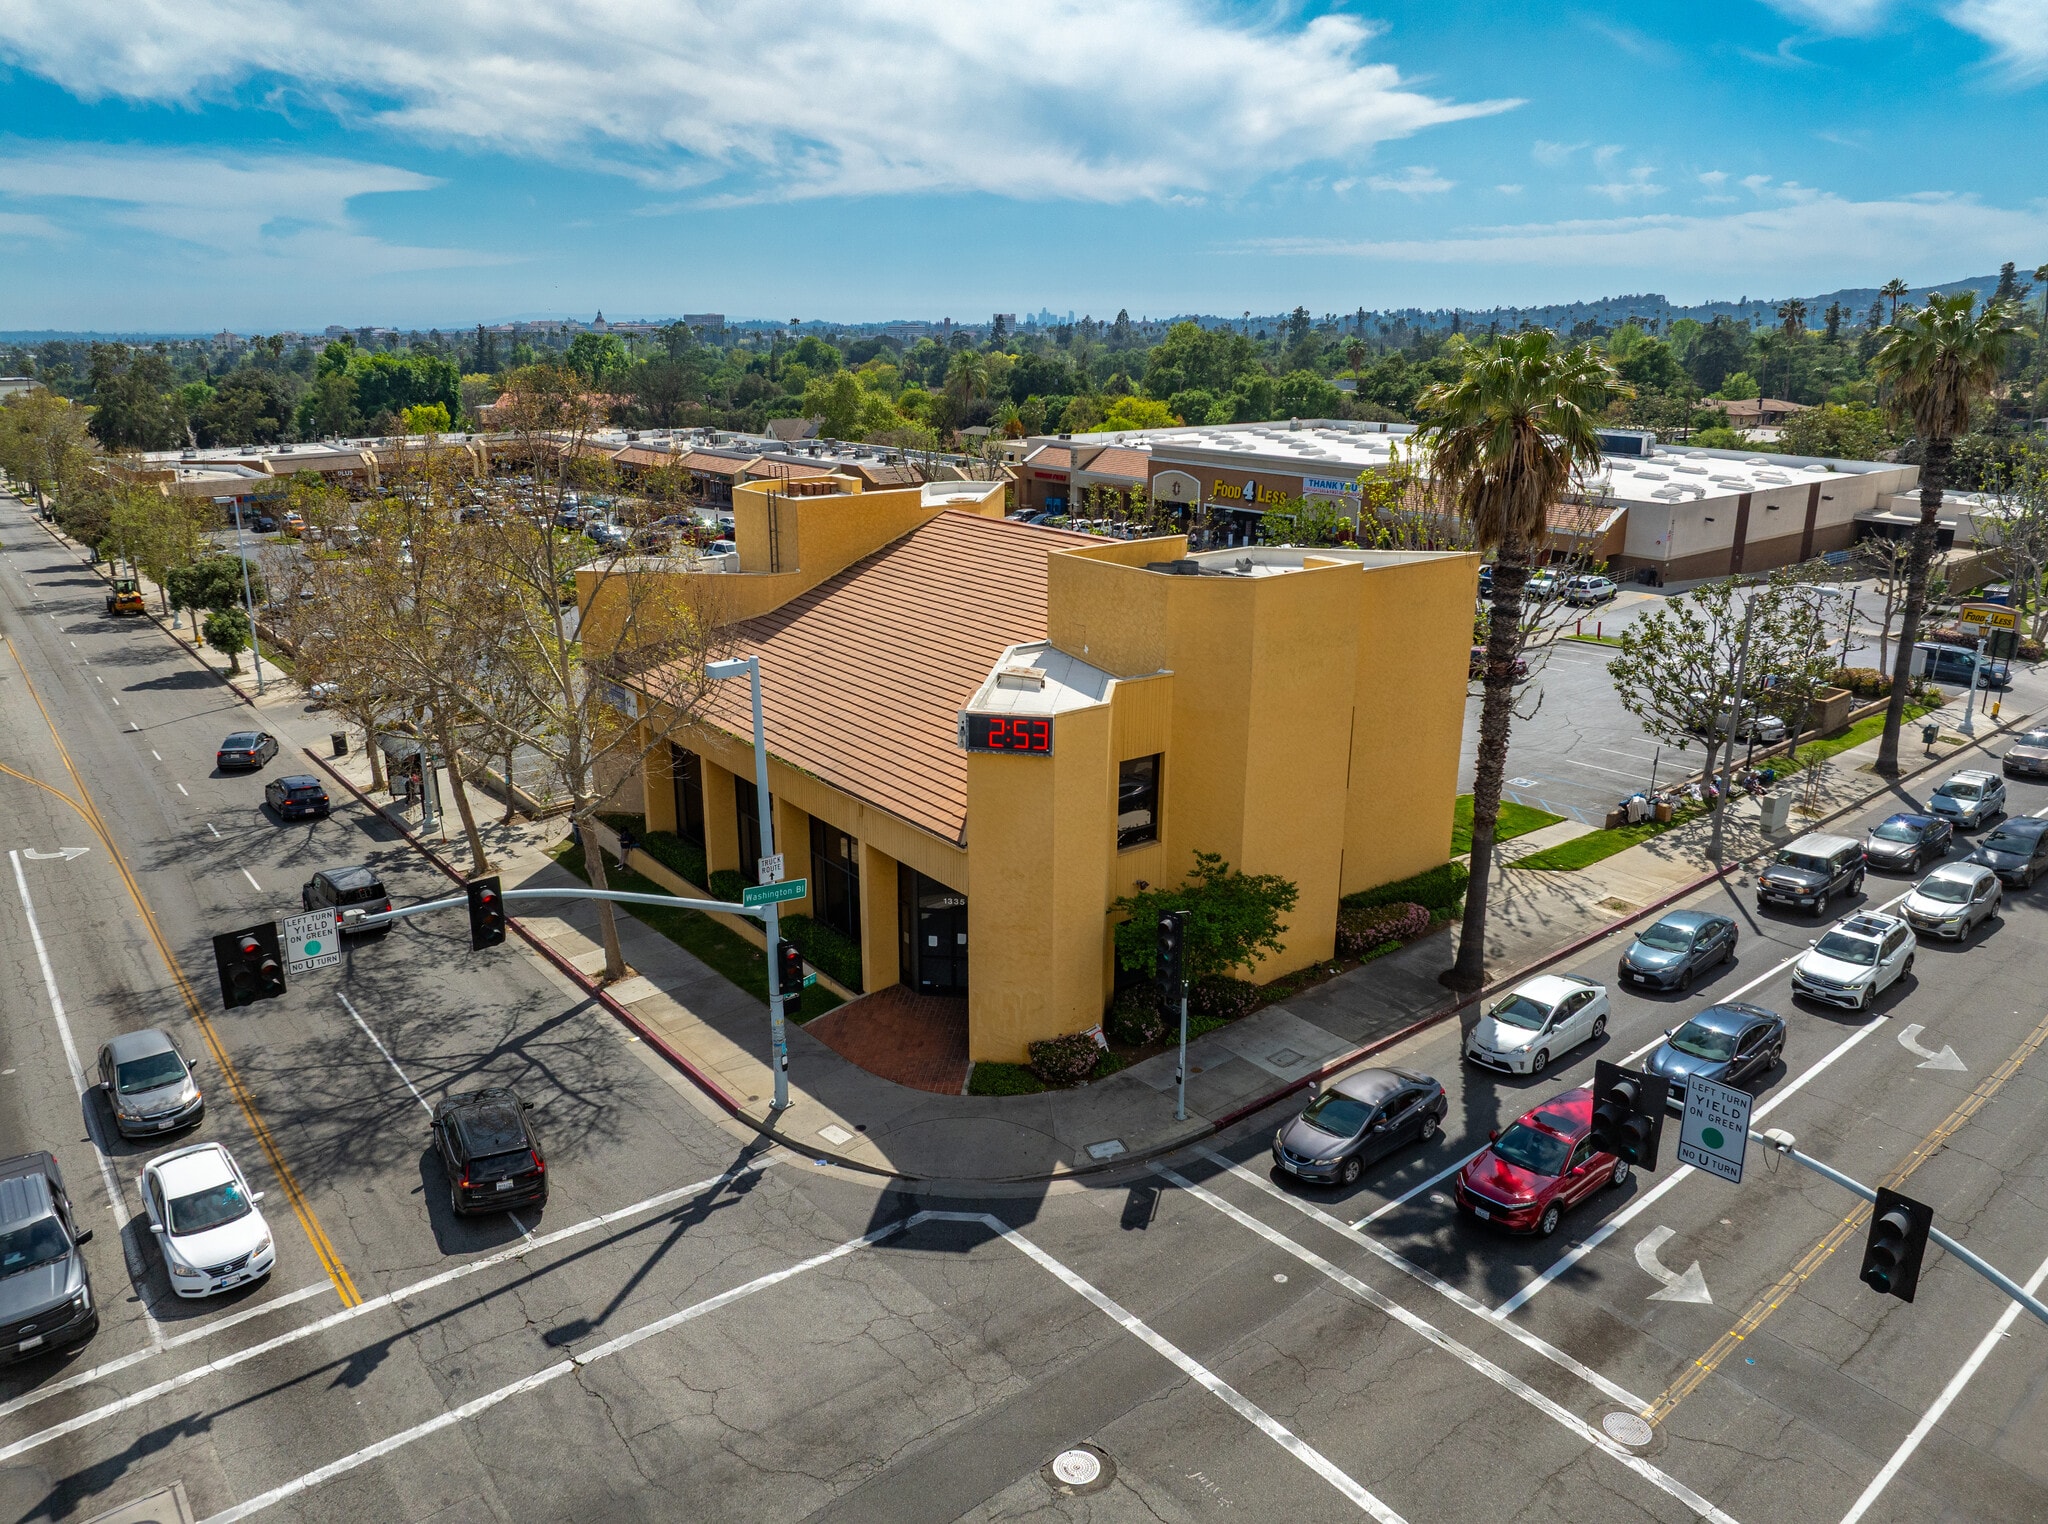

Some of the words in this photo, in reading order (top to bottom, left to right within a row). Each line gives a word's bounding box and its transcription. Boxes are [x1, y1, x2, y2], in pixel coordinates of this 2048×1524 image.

[1243, 480, 1255, 502] 4
[1309, 479, 1338, 490] THANK
[1340, 482, 1358, 491] YU
[989, 718, 1049, 750] 2:53
[761, 856, 782, 867] TRUCK
[761, 864, 782, 874] ROUTE
[746, 888, 793, 902] Washington
[943, 897, 966, 906] 1335
[287, 917, 307, 928] LEFT
[311, 911, 333, 921] TURN
[294, 920, 328, 934] YIELD
[290, 936, 302, 944] ON
[306, 928, 333, 940] GREEN
[292, 963, 303, 972] NO
[306, 960, 314, 969] U
[317, 955, 338, 965] TURN
[1692, 1081, 1716, 1097] LEFT
[1721, 1092, 1747, 1109] TURN
[1696, 1094, 1741, 1119] YIELD
[1690, 1106, 1703, 1118] ON
[1708, 1114, 1742, 1133] GREEN
[1682, 1148, 1695, 1159] NO
[1698, 1153, 1709, 1166] U
[1712, 1160, 1737, 1177] TURN
